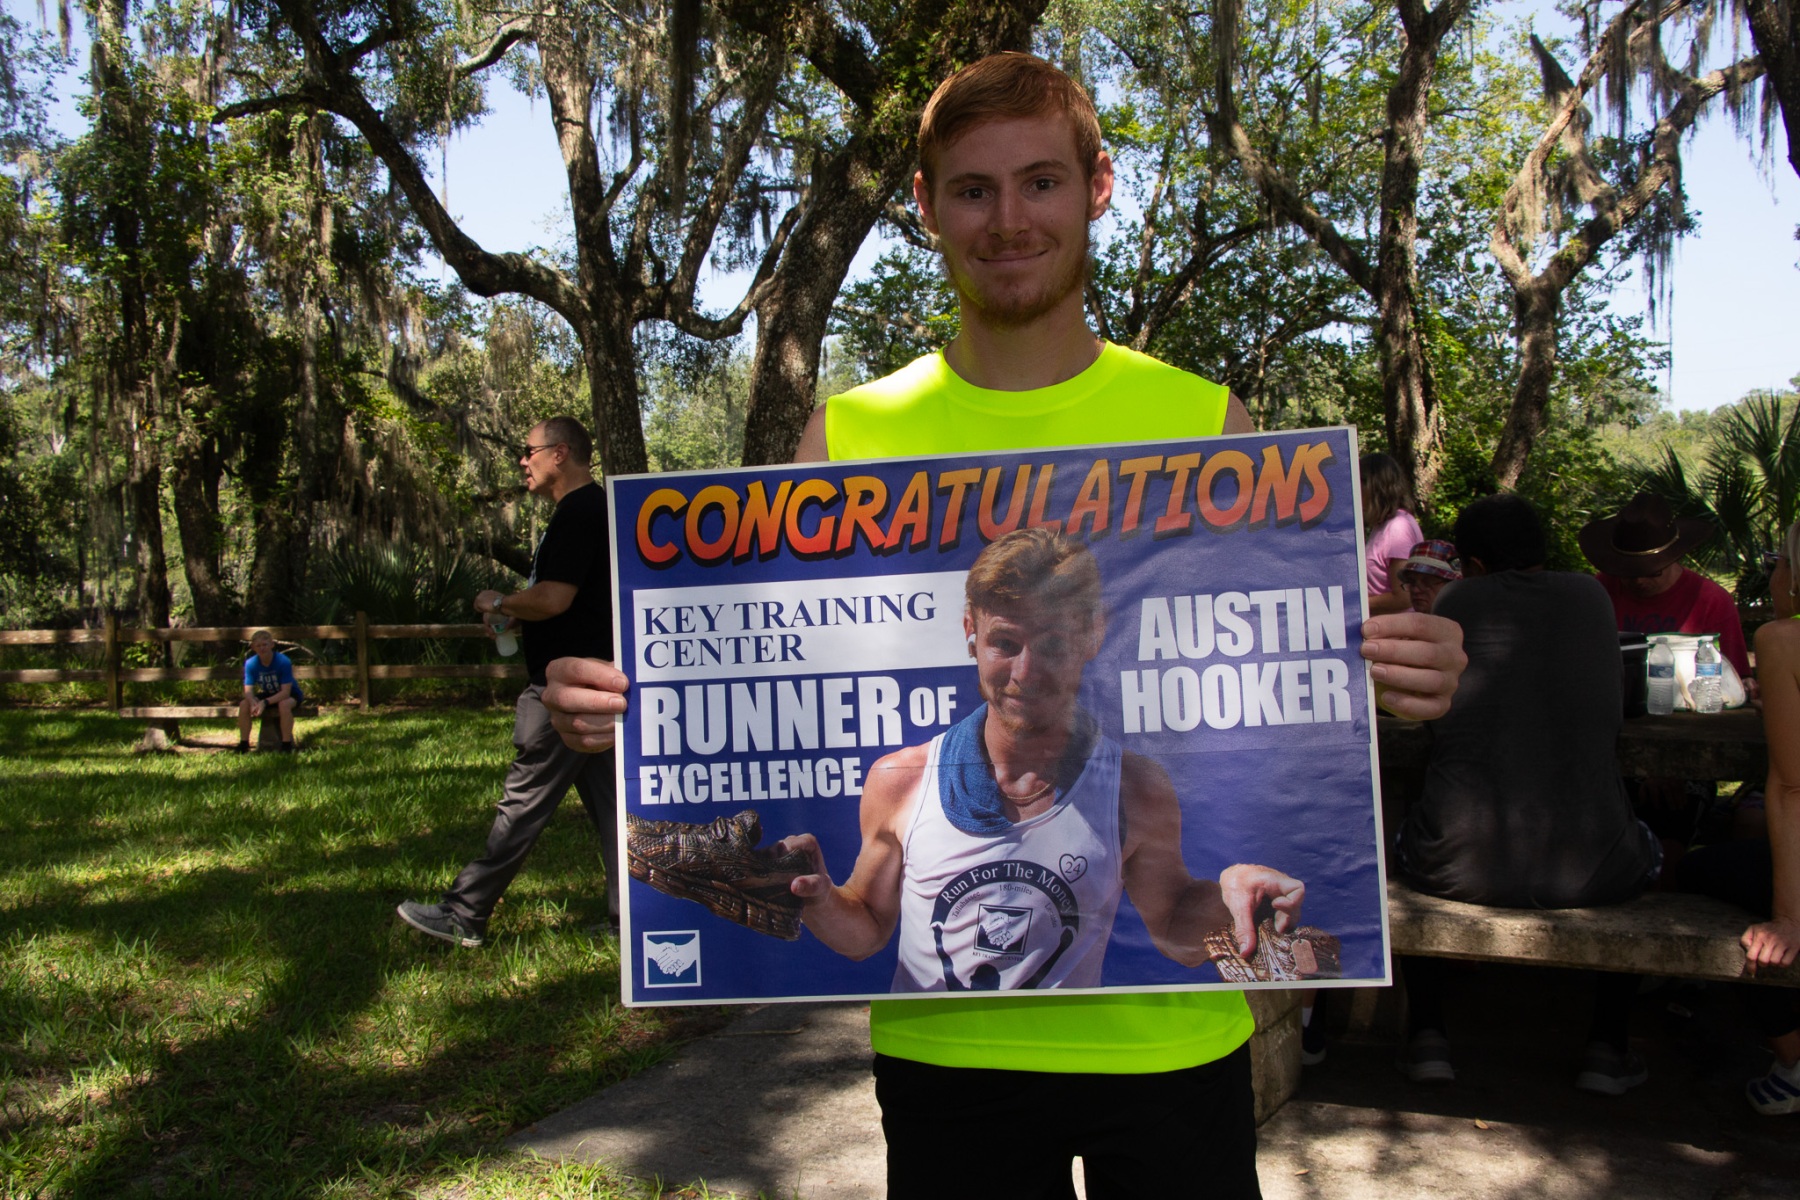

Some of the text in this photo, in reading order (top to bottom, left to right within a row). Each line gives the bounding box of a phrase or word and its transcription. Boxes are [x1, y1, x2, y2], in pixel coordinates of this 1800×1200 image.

[635, 441, 1335, 568] CONGRATULATIONS
[642, 591, 937, 636] KEY TRAINING
[1137, 585, 1348, 662] AUSTIN
[643, 633, 807, 669] CENTER
[640, 675, 957, 757] RUNNER OF
[1120, 658, 1352, 734] HOOKER
[639, 757, 864, 806] EXCELLENCE
[941, 862, 1073, 914] Run For The Money
[1065, 861, 1081, 875] 24
